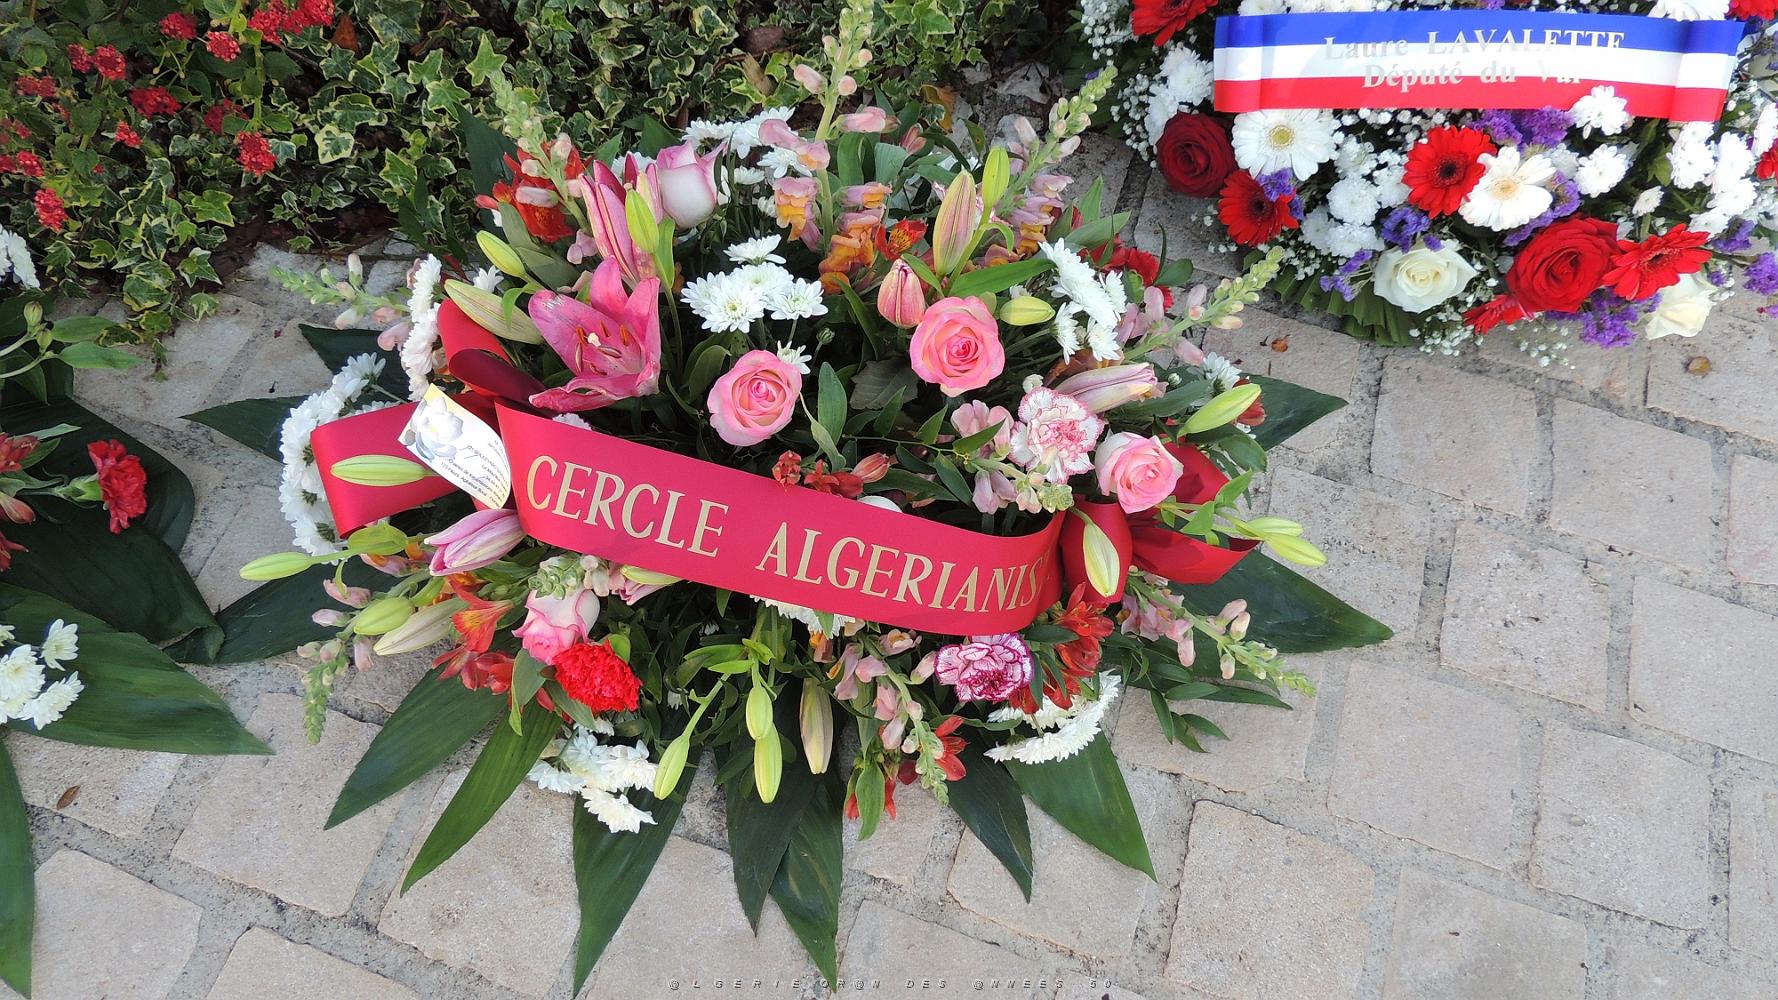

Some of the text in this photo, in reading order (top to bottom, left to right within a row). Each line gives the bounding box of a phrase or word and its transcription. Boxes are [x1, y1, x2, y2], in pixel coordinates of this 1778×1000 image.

[1324, 28, 1625, 61] Laure LAVALETTE
[1361, 61, 1464, 93] Député
[1480, 60, 1516, 83] du
[526, 455, 729, 558] CERCLE
[754, 521, 1049, 613] ALGERIANIS
